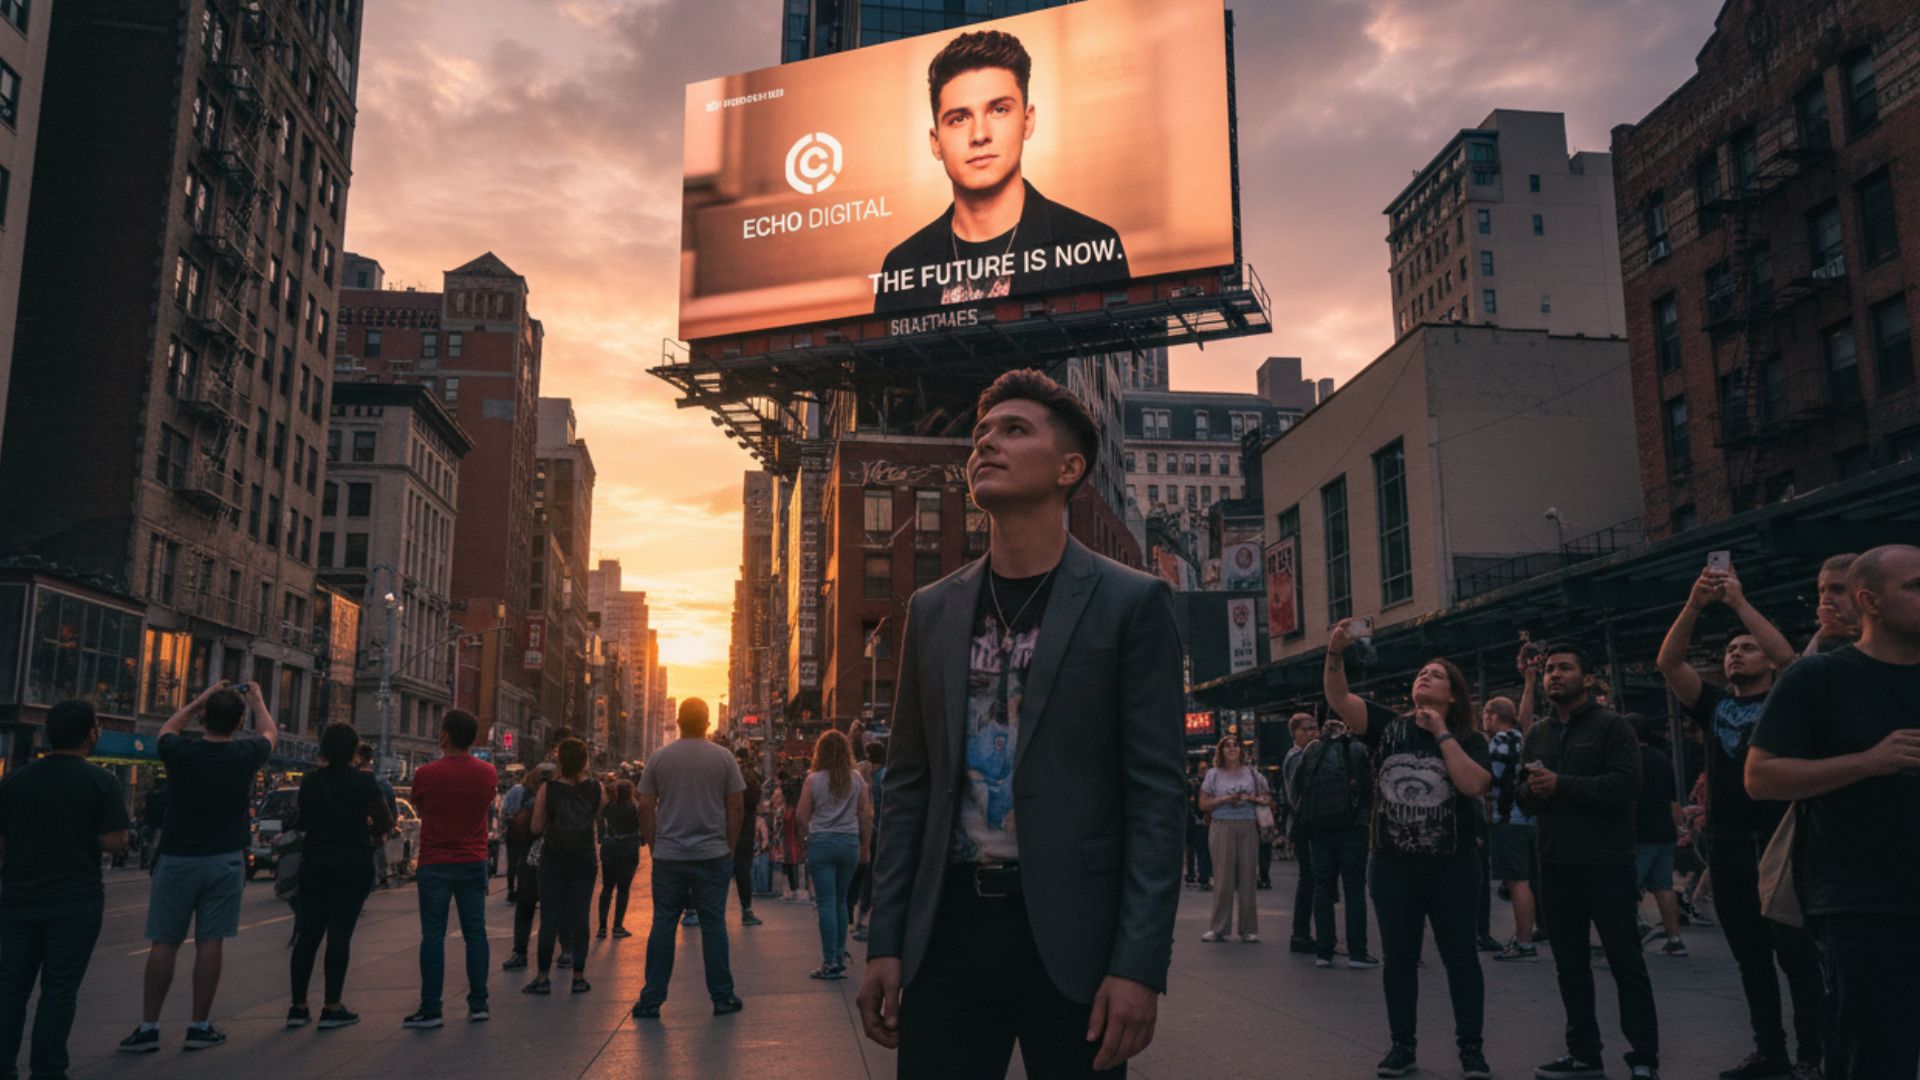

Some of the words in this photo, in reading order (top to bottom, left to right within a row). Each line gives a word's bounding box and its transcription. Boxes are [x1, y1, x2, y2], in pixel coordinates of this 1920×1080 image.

[743, 211, 802, 239] ECHO
[809, 196, 892, 228] DIGITAL
[868, 268, 915, 295] THE
[921, 252, 1015, 287] FUTURE
[1023, 248, 1047, 273] IS
[1055, 238, 1123, 268] NOW.
